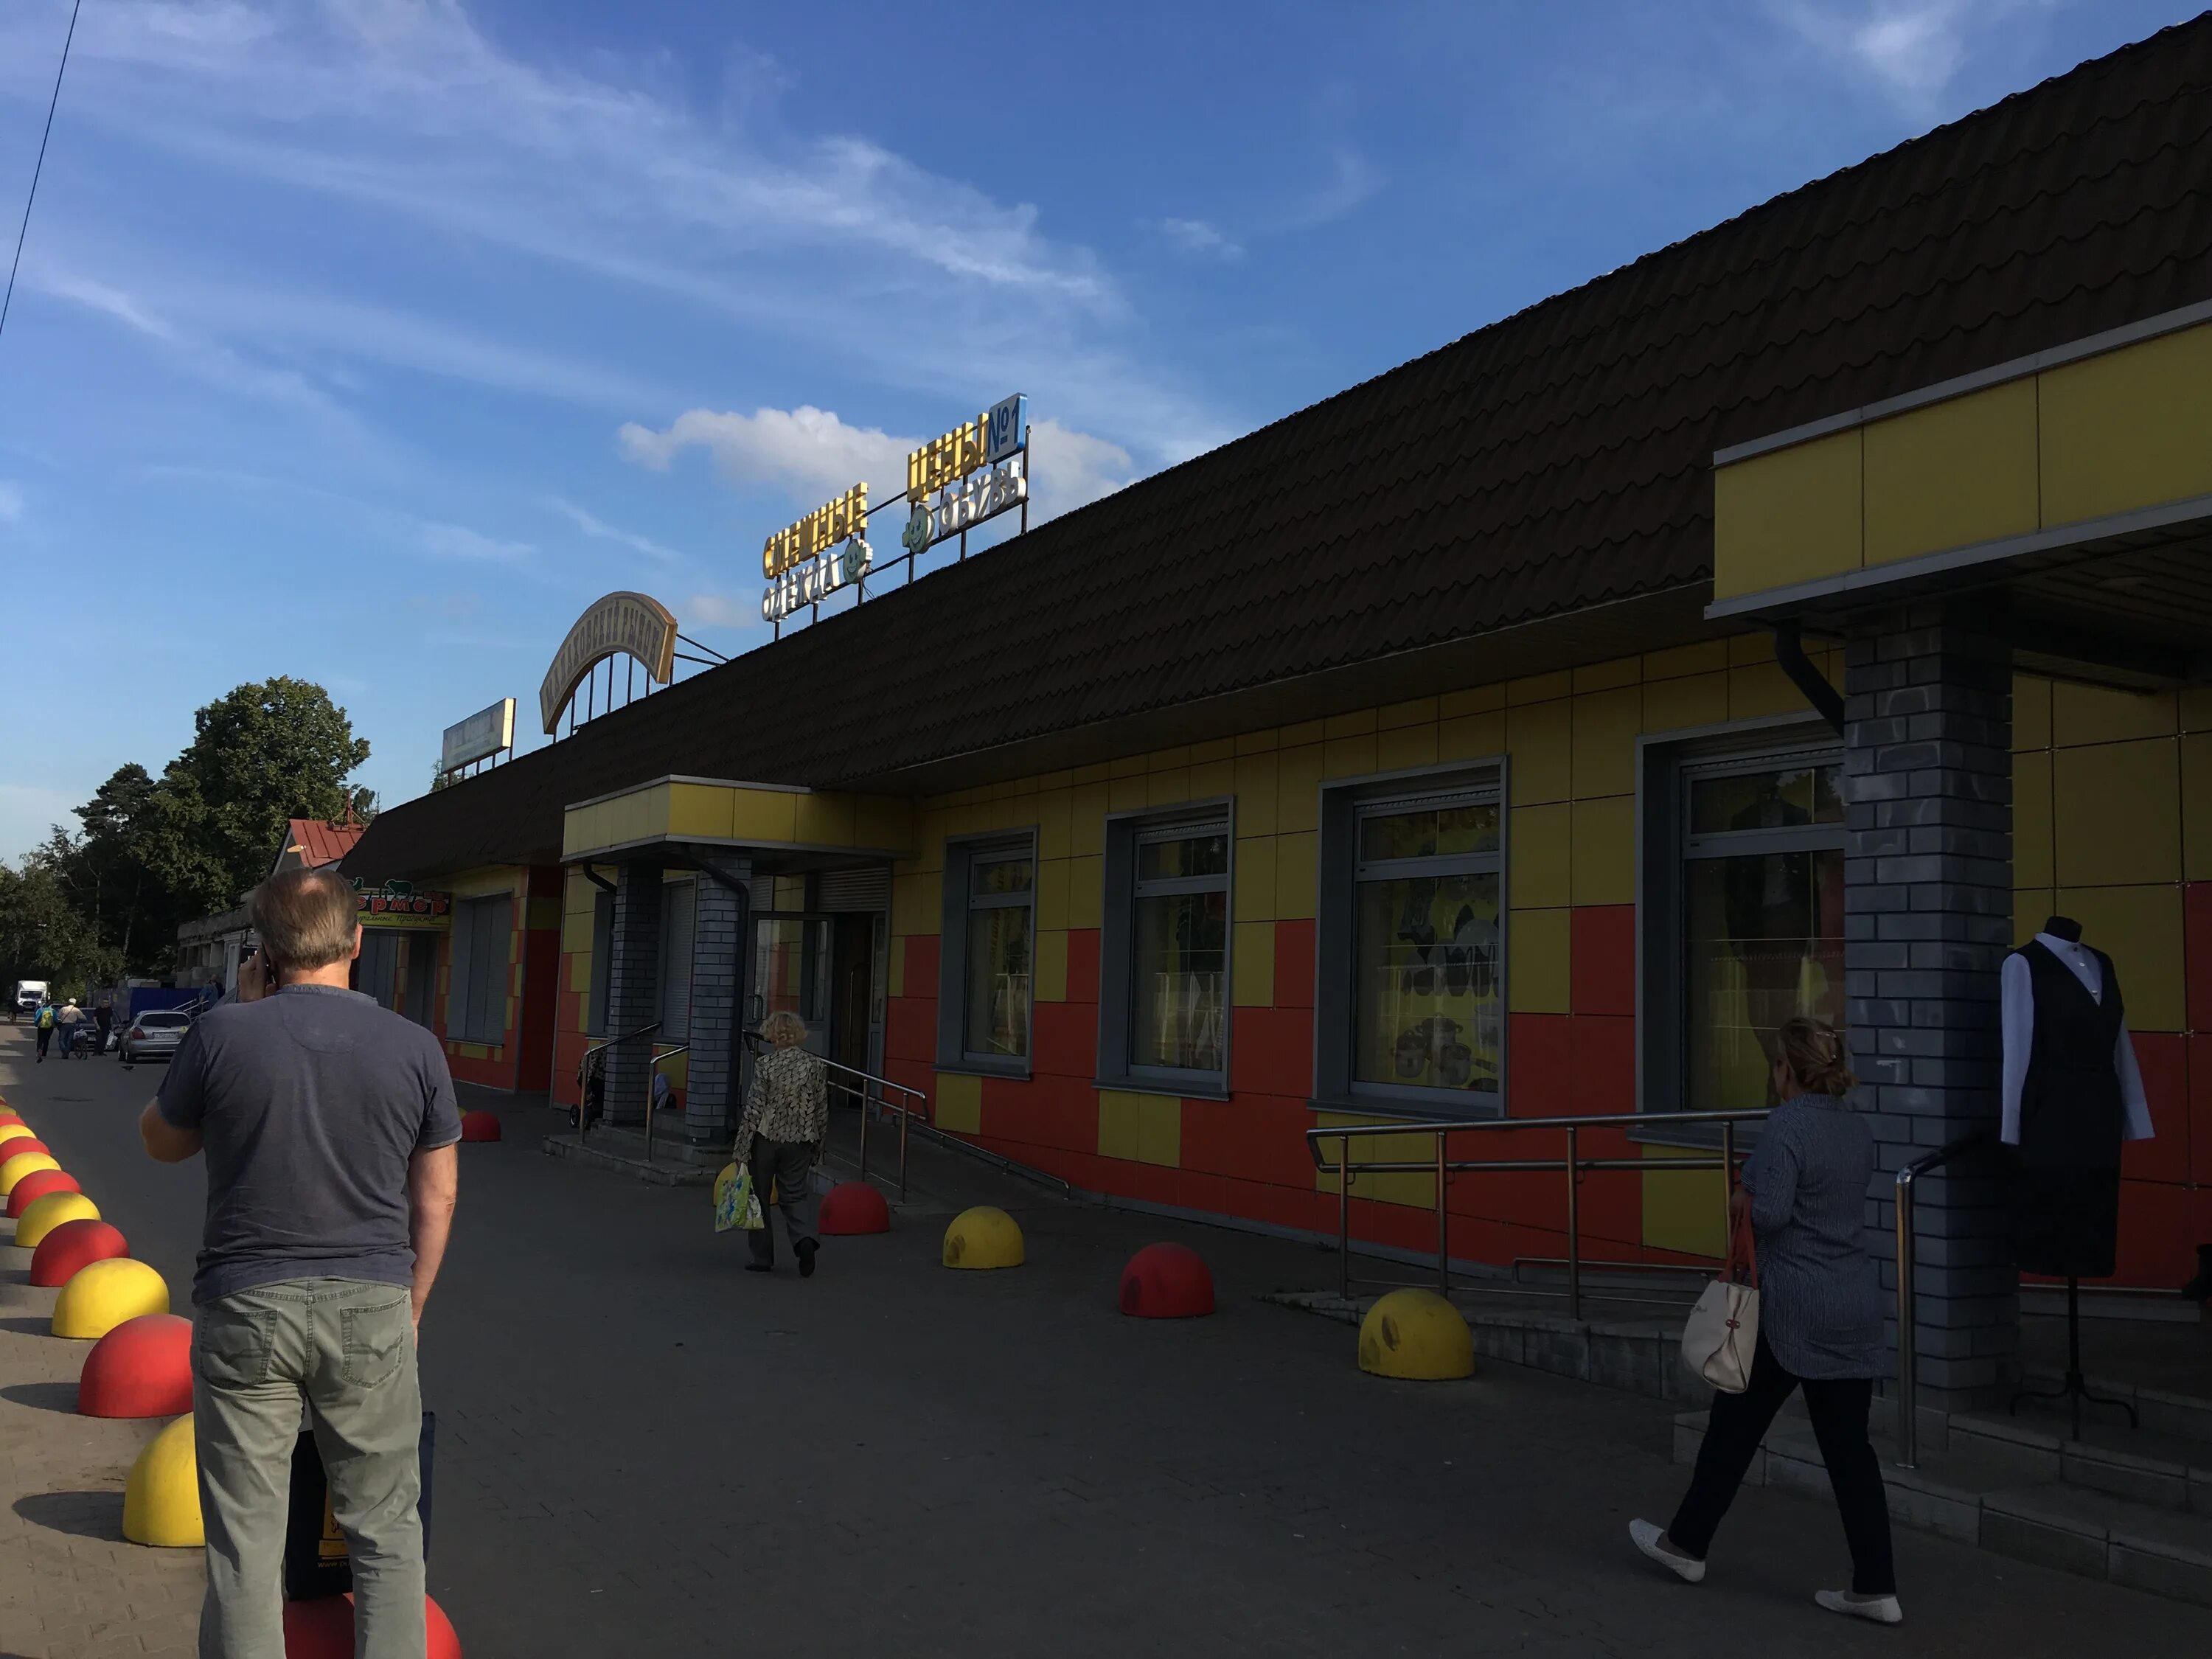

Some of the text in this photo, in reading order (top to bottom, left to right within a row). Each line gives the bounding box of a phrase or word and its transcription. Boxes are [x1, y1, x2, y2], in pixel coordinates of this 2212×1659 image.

[762, 399, 1020, 580] СМЕШНЫЕ ЦЕНЫ №1
[762, 461, 1026, 623] ОДЕЖДА ОБУВЬ
[546, 599, 660, 715] МАЛАХОВСКИЙ РЫНОК
[355, 896, 447, 917] ермер
